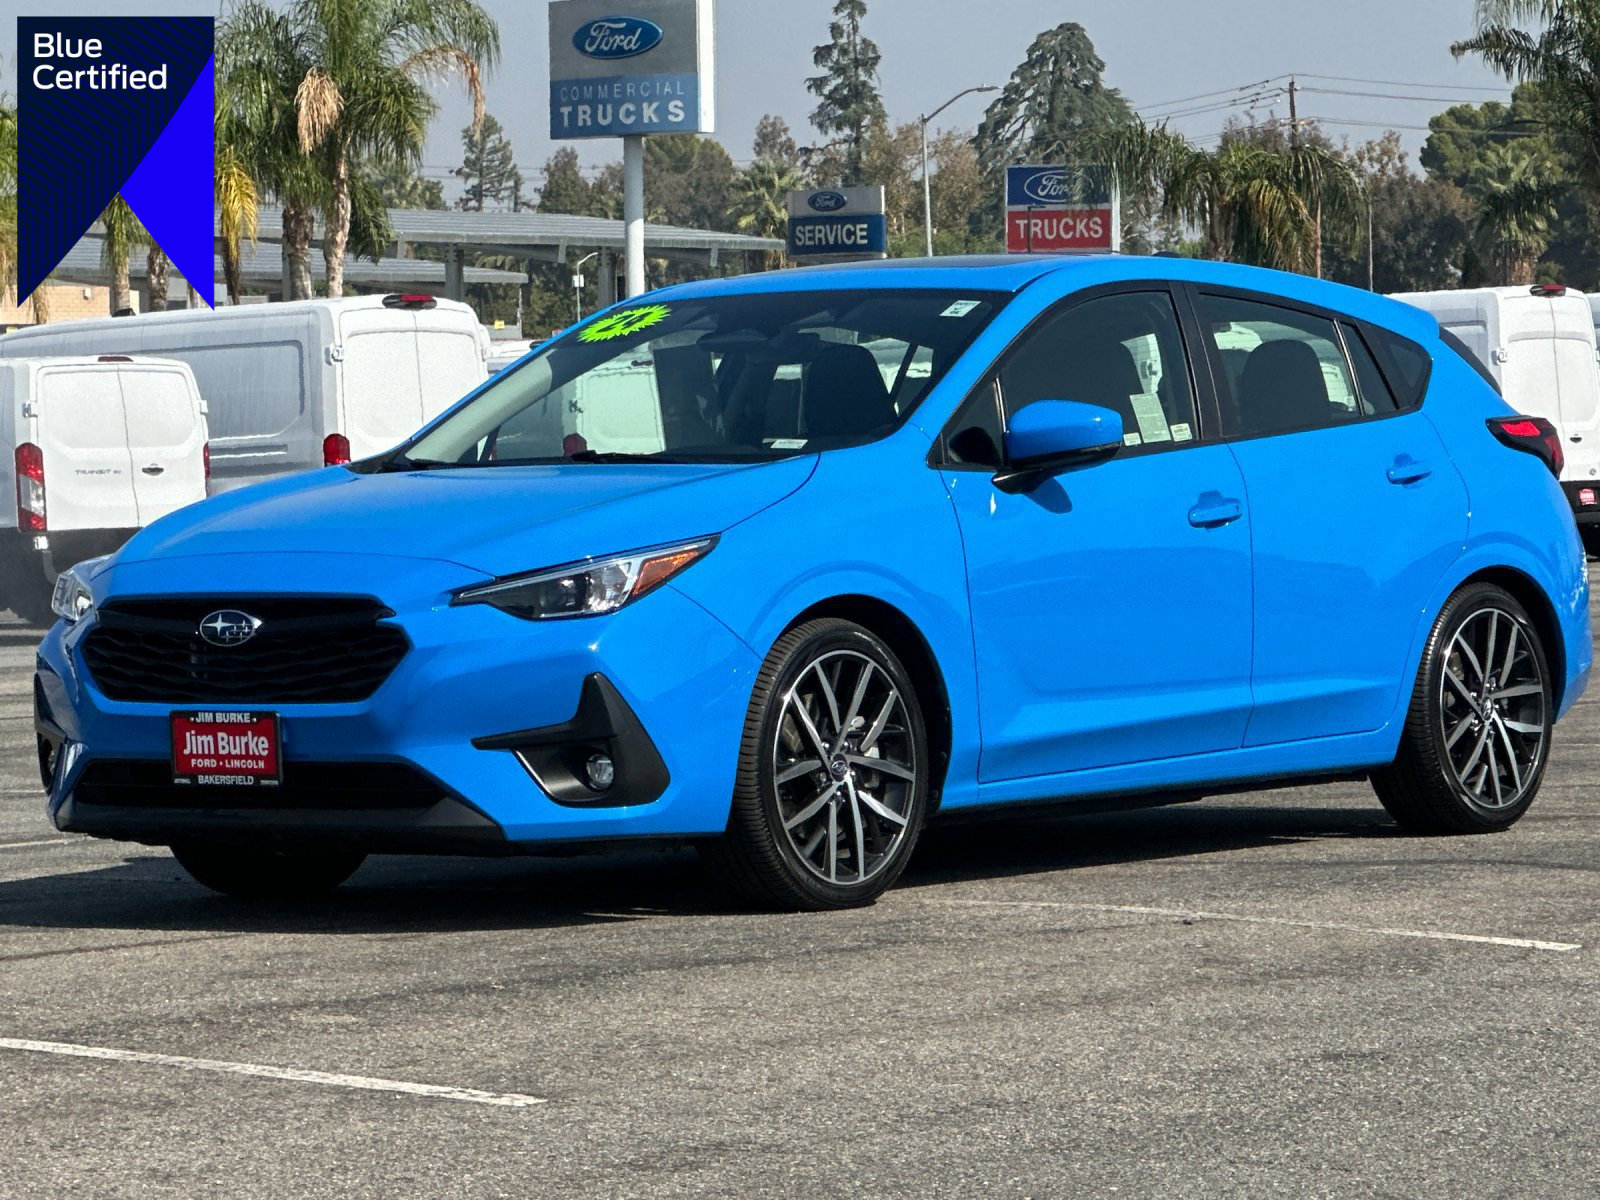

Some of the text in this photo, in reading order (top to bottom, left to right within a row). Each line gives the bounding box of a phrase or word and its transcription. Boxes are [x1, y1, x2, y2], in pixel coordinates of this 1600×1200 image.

[584, 22, 641, 52] Ford
[560, 80, 685, 101] COMMERCIAL
[560, 100, 686, 128] TRUCKS
[815, 195, 837, 207] Ford
[795, 223, 868, 246] SERVICE
[1016, 216, 1103, 239] TRUCKS
[196, 712, 250, 723] JIM BURKE
[183, 730, 269, 756] Jim Burke
[191, 759, 265, 769] FORD LINCOLN
[198, 775, 254, 785] BAKERSFIELD
